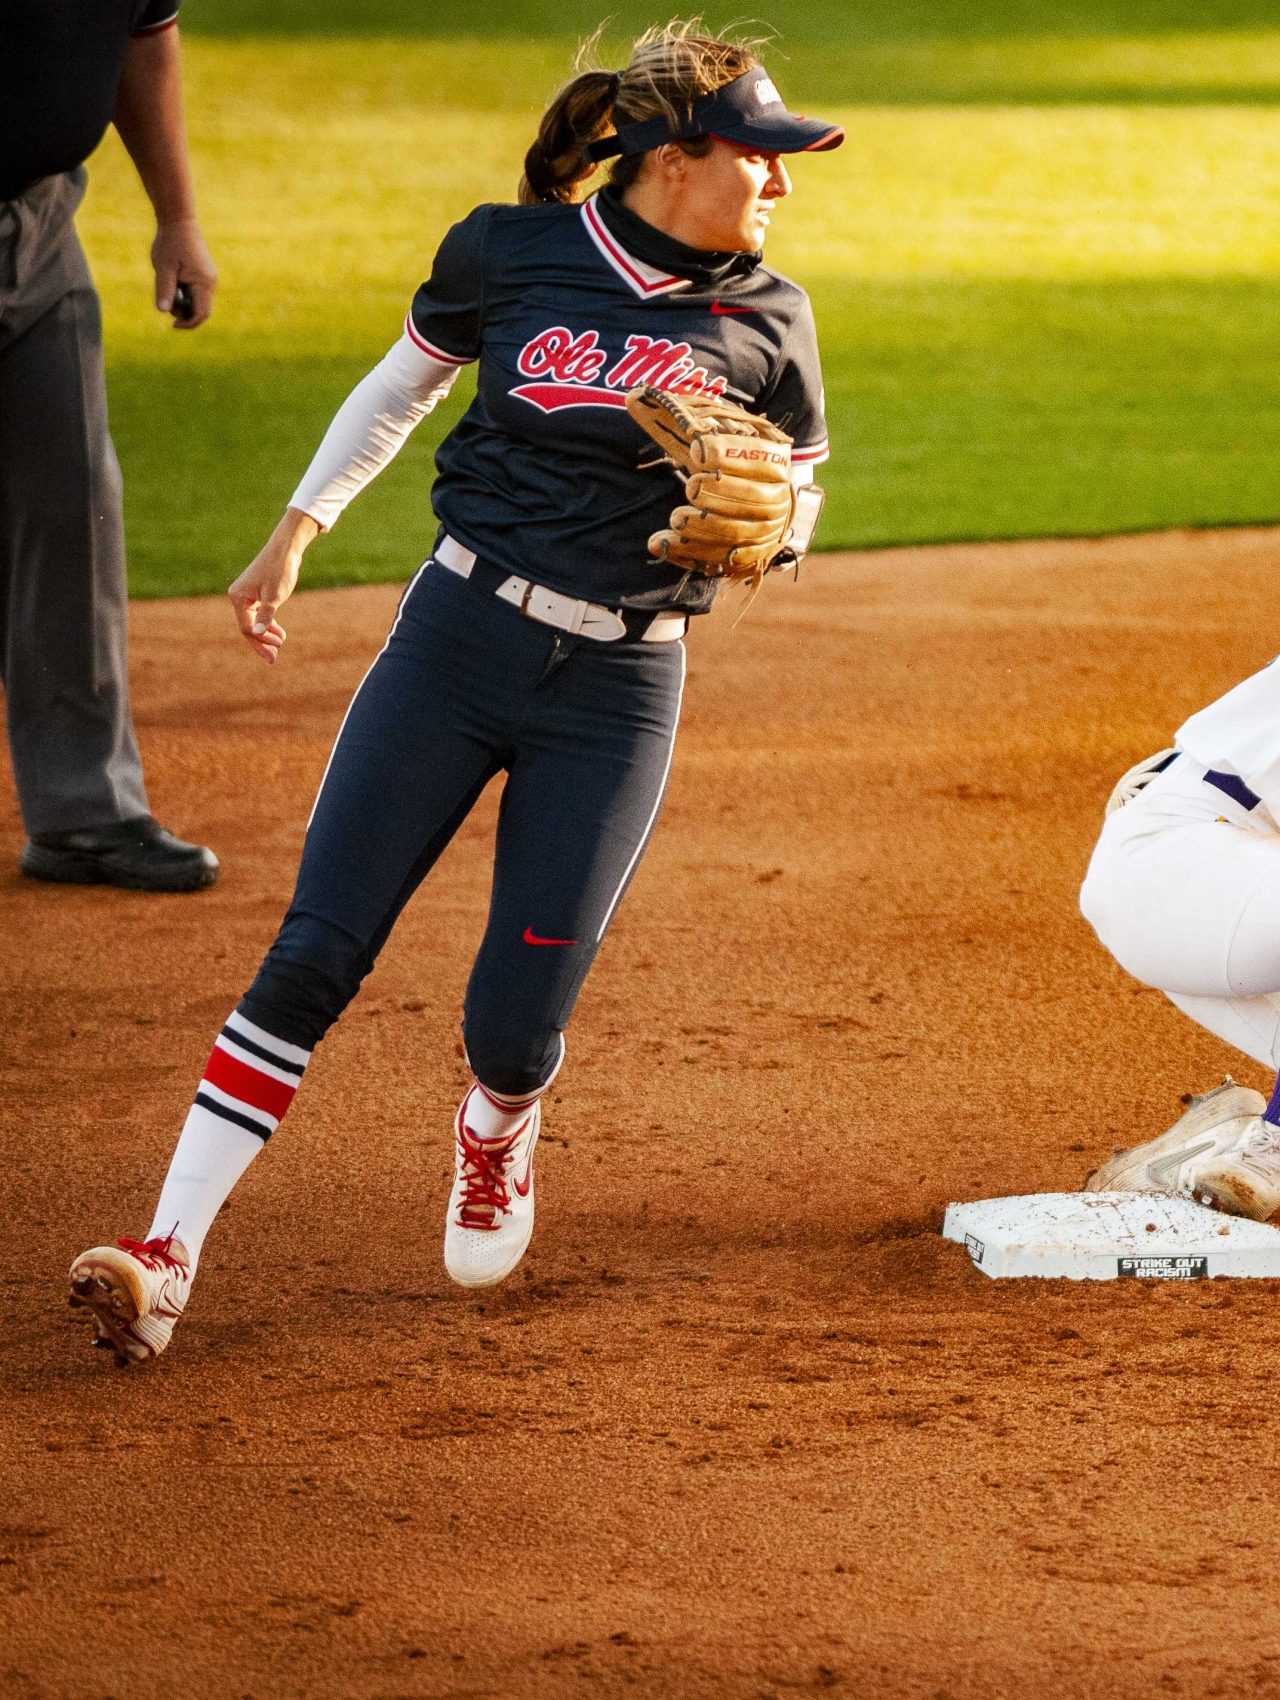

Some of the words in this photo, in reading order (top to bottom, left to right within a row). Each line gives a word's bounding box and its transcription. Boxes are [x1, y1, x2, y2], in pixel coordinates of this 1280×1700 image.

[518, 326, 607, 384] Ole
[725, 447, 788, 466] EASTON
[1122, 1258, 1172, 1269] STRIKE
[1175, 1258, 1204, 1268] OUT
[1135, 1267, 1191, 1278] RACISM
